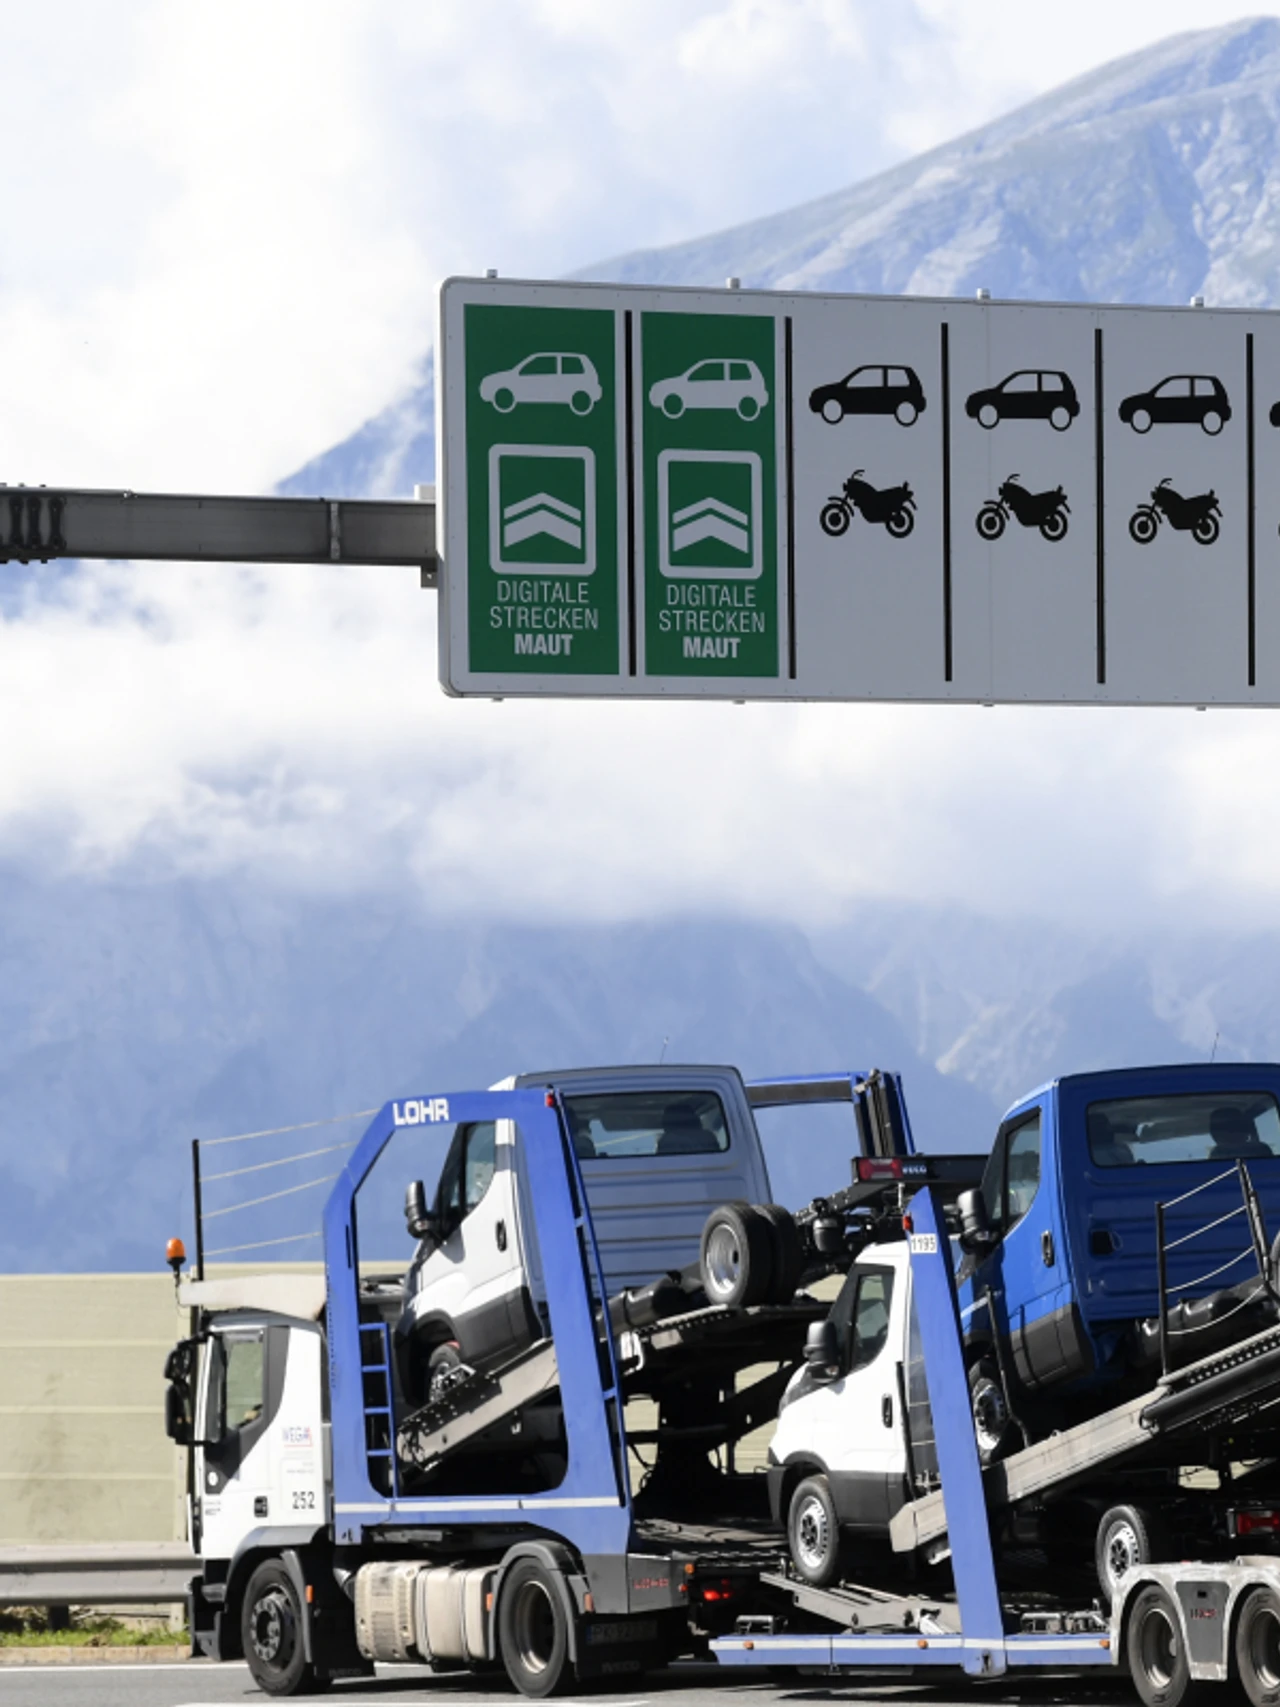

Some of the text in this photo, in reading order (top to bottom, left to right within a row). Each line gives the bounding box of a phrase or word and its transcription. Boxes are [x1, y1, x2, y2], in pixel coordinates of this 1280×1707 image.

[497, 580, 589, 603] DIGITALE
[667, 584, 756, 607] DIGITALE
[489, 606, 599, 630] STRECKEN
[658, 610, 765, 633] STRECKEN
[514, 633, 573, 656] MAUT
[682, 636, 741, 659] MAUT
[392, 1098, 450, 1126] LOHR
[292, 1491, 315, 1510] 252
